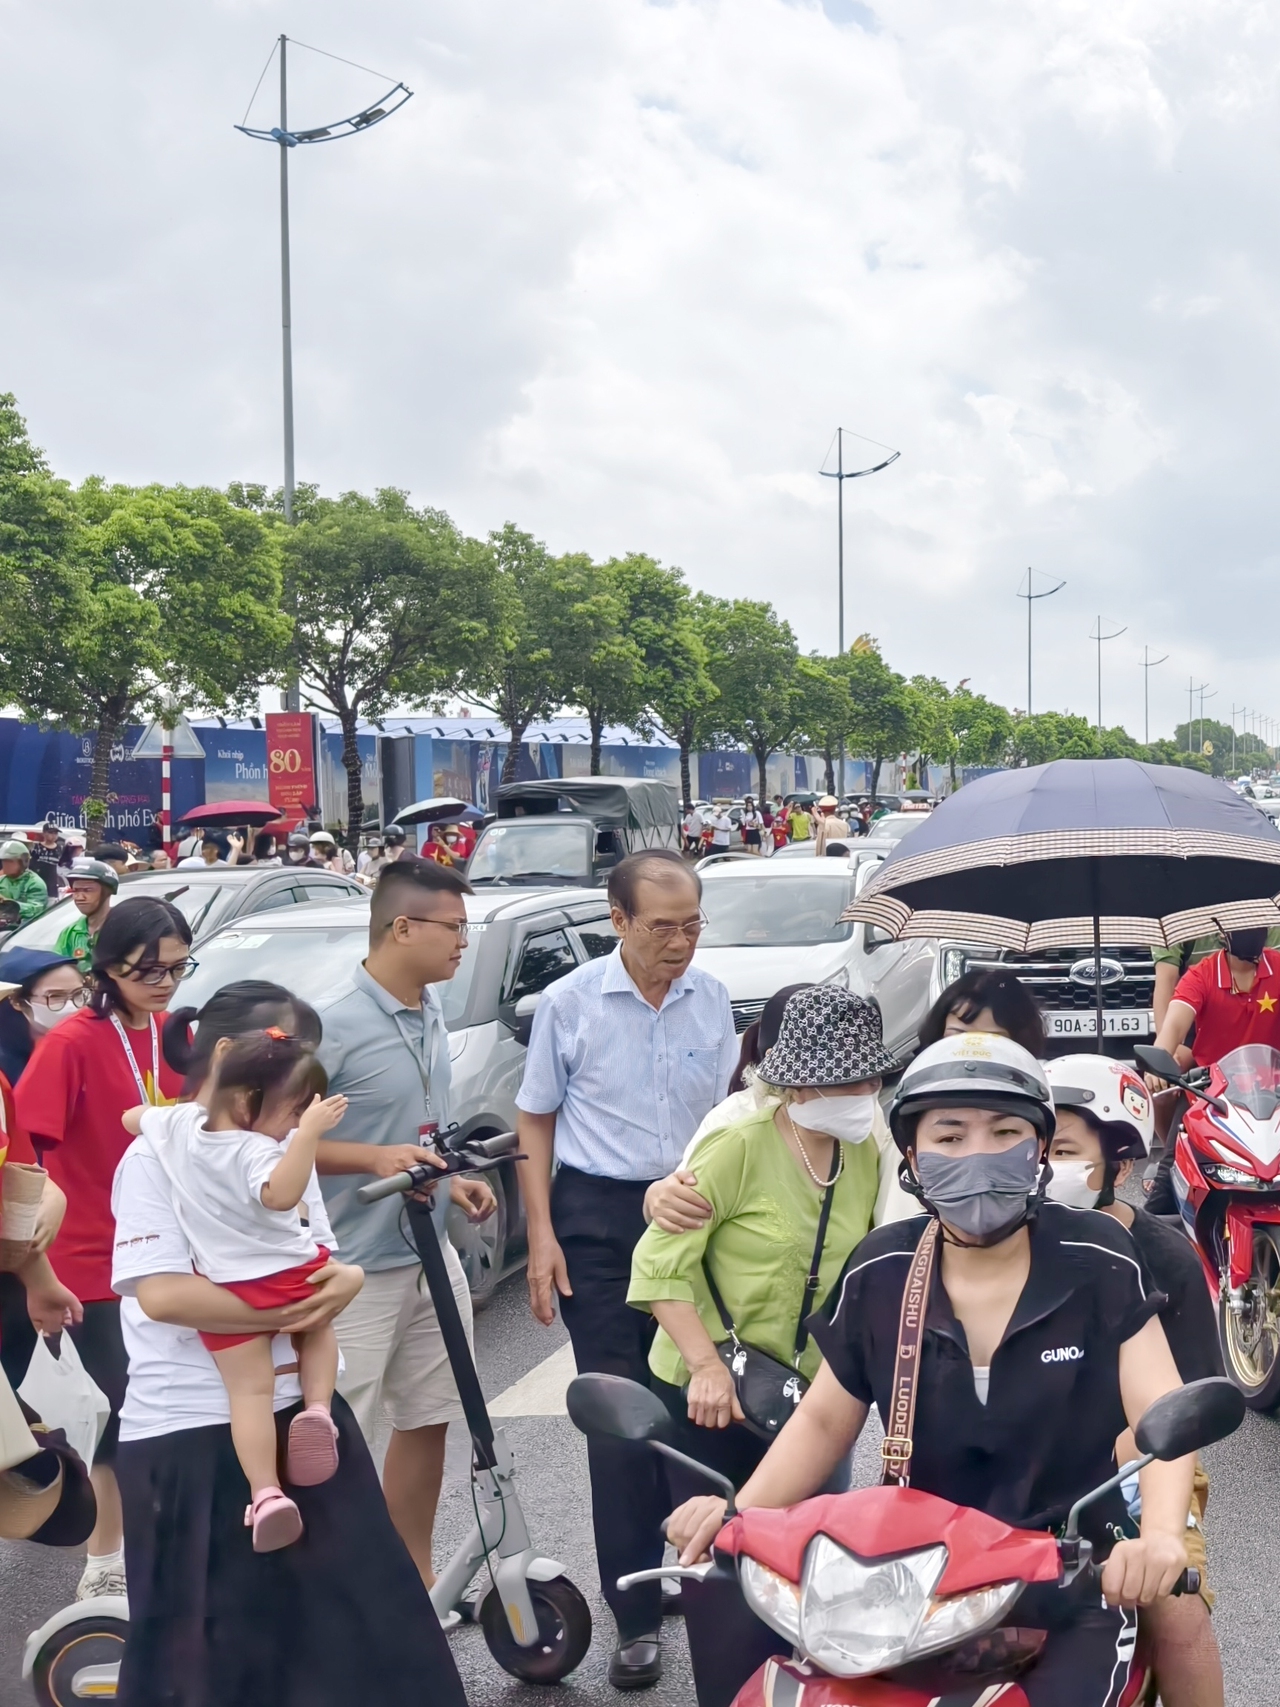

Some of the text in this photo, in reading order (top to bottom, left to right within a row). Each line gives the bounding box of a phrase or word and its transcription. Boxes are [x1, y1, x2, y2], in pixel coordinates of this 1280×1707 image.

[269, 748, 301, 773] 80
[118, 808, 140, 830] phố
[143, 809, 157, 826] Ex
